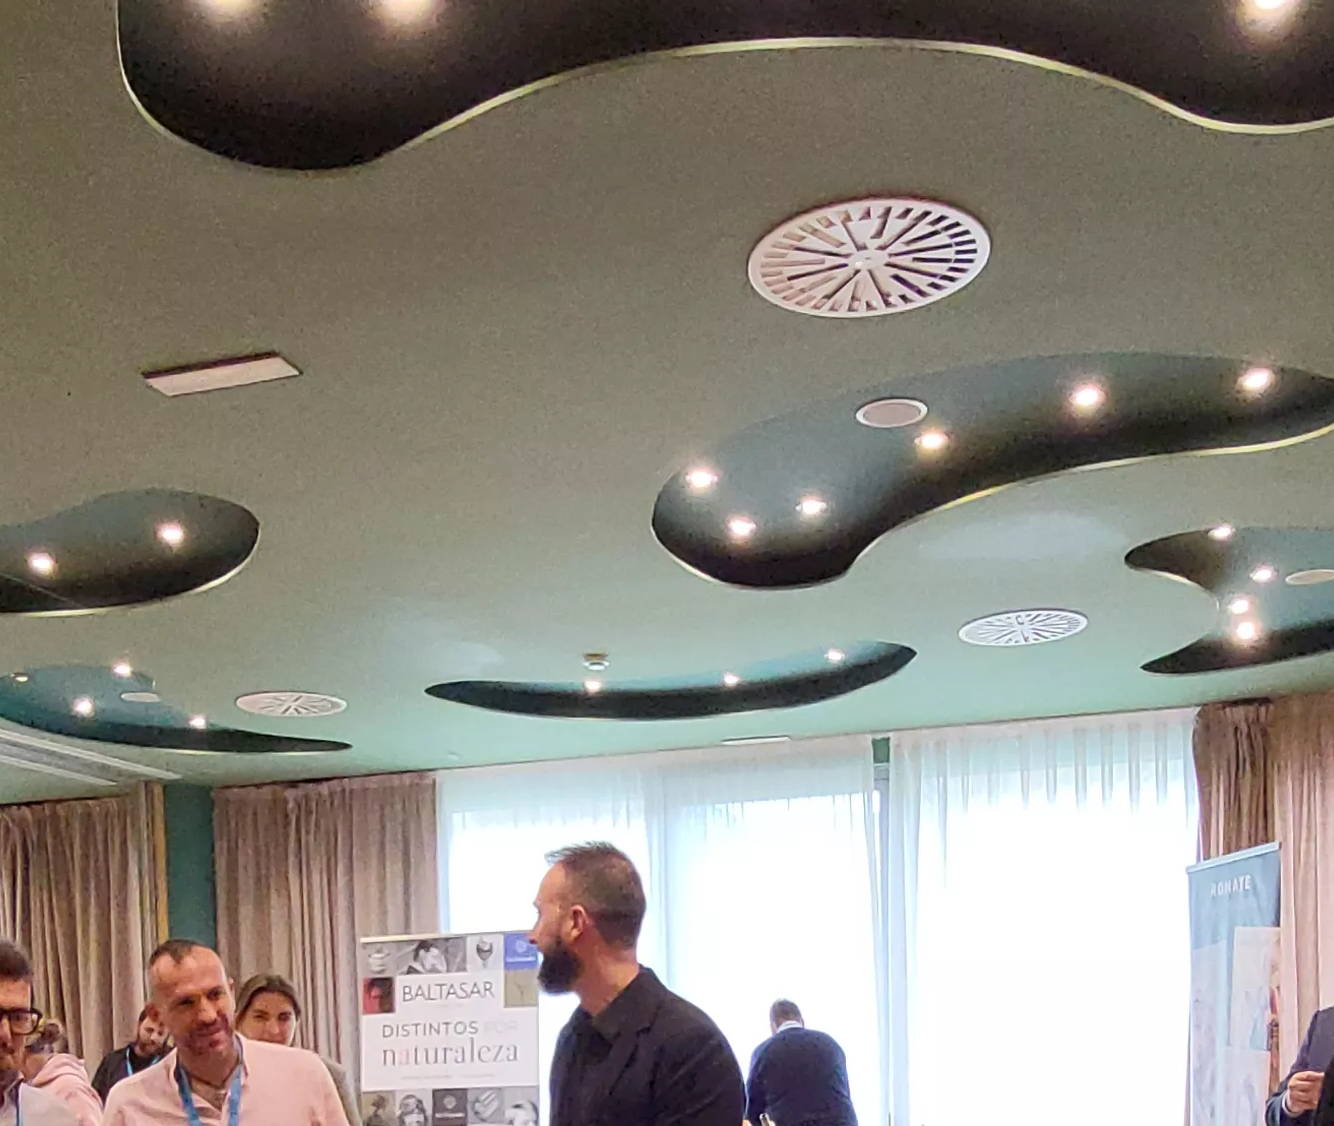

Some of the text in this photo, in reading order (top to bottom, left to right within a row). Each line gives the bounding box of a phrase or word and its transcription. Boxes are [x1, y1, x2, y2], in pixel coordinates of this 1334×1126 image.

[402, 981, 496, 1002] BALTASAR
[382, 1020, 479, 1038] DISTINTOS
[382, 1037, 519, 1066] naturaleza
